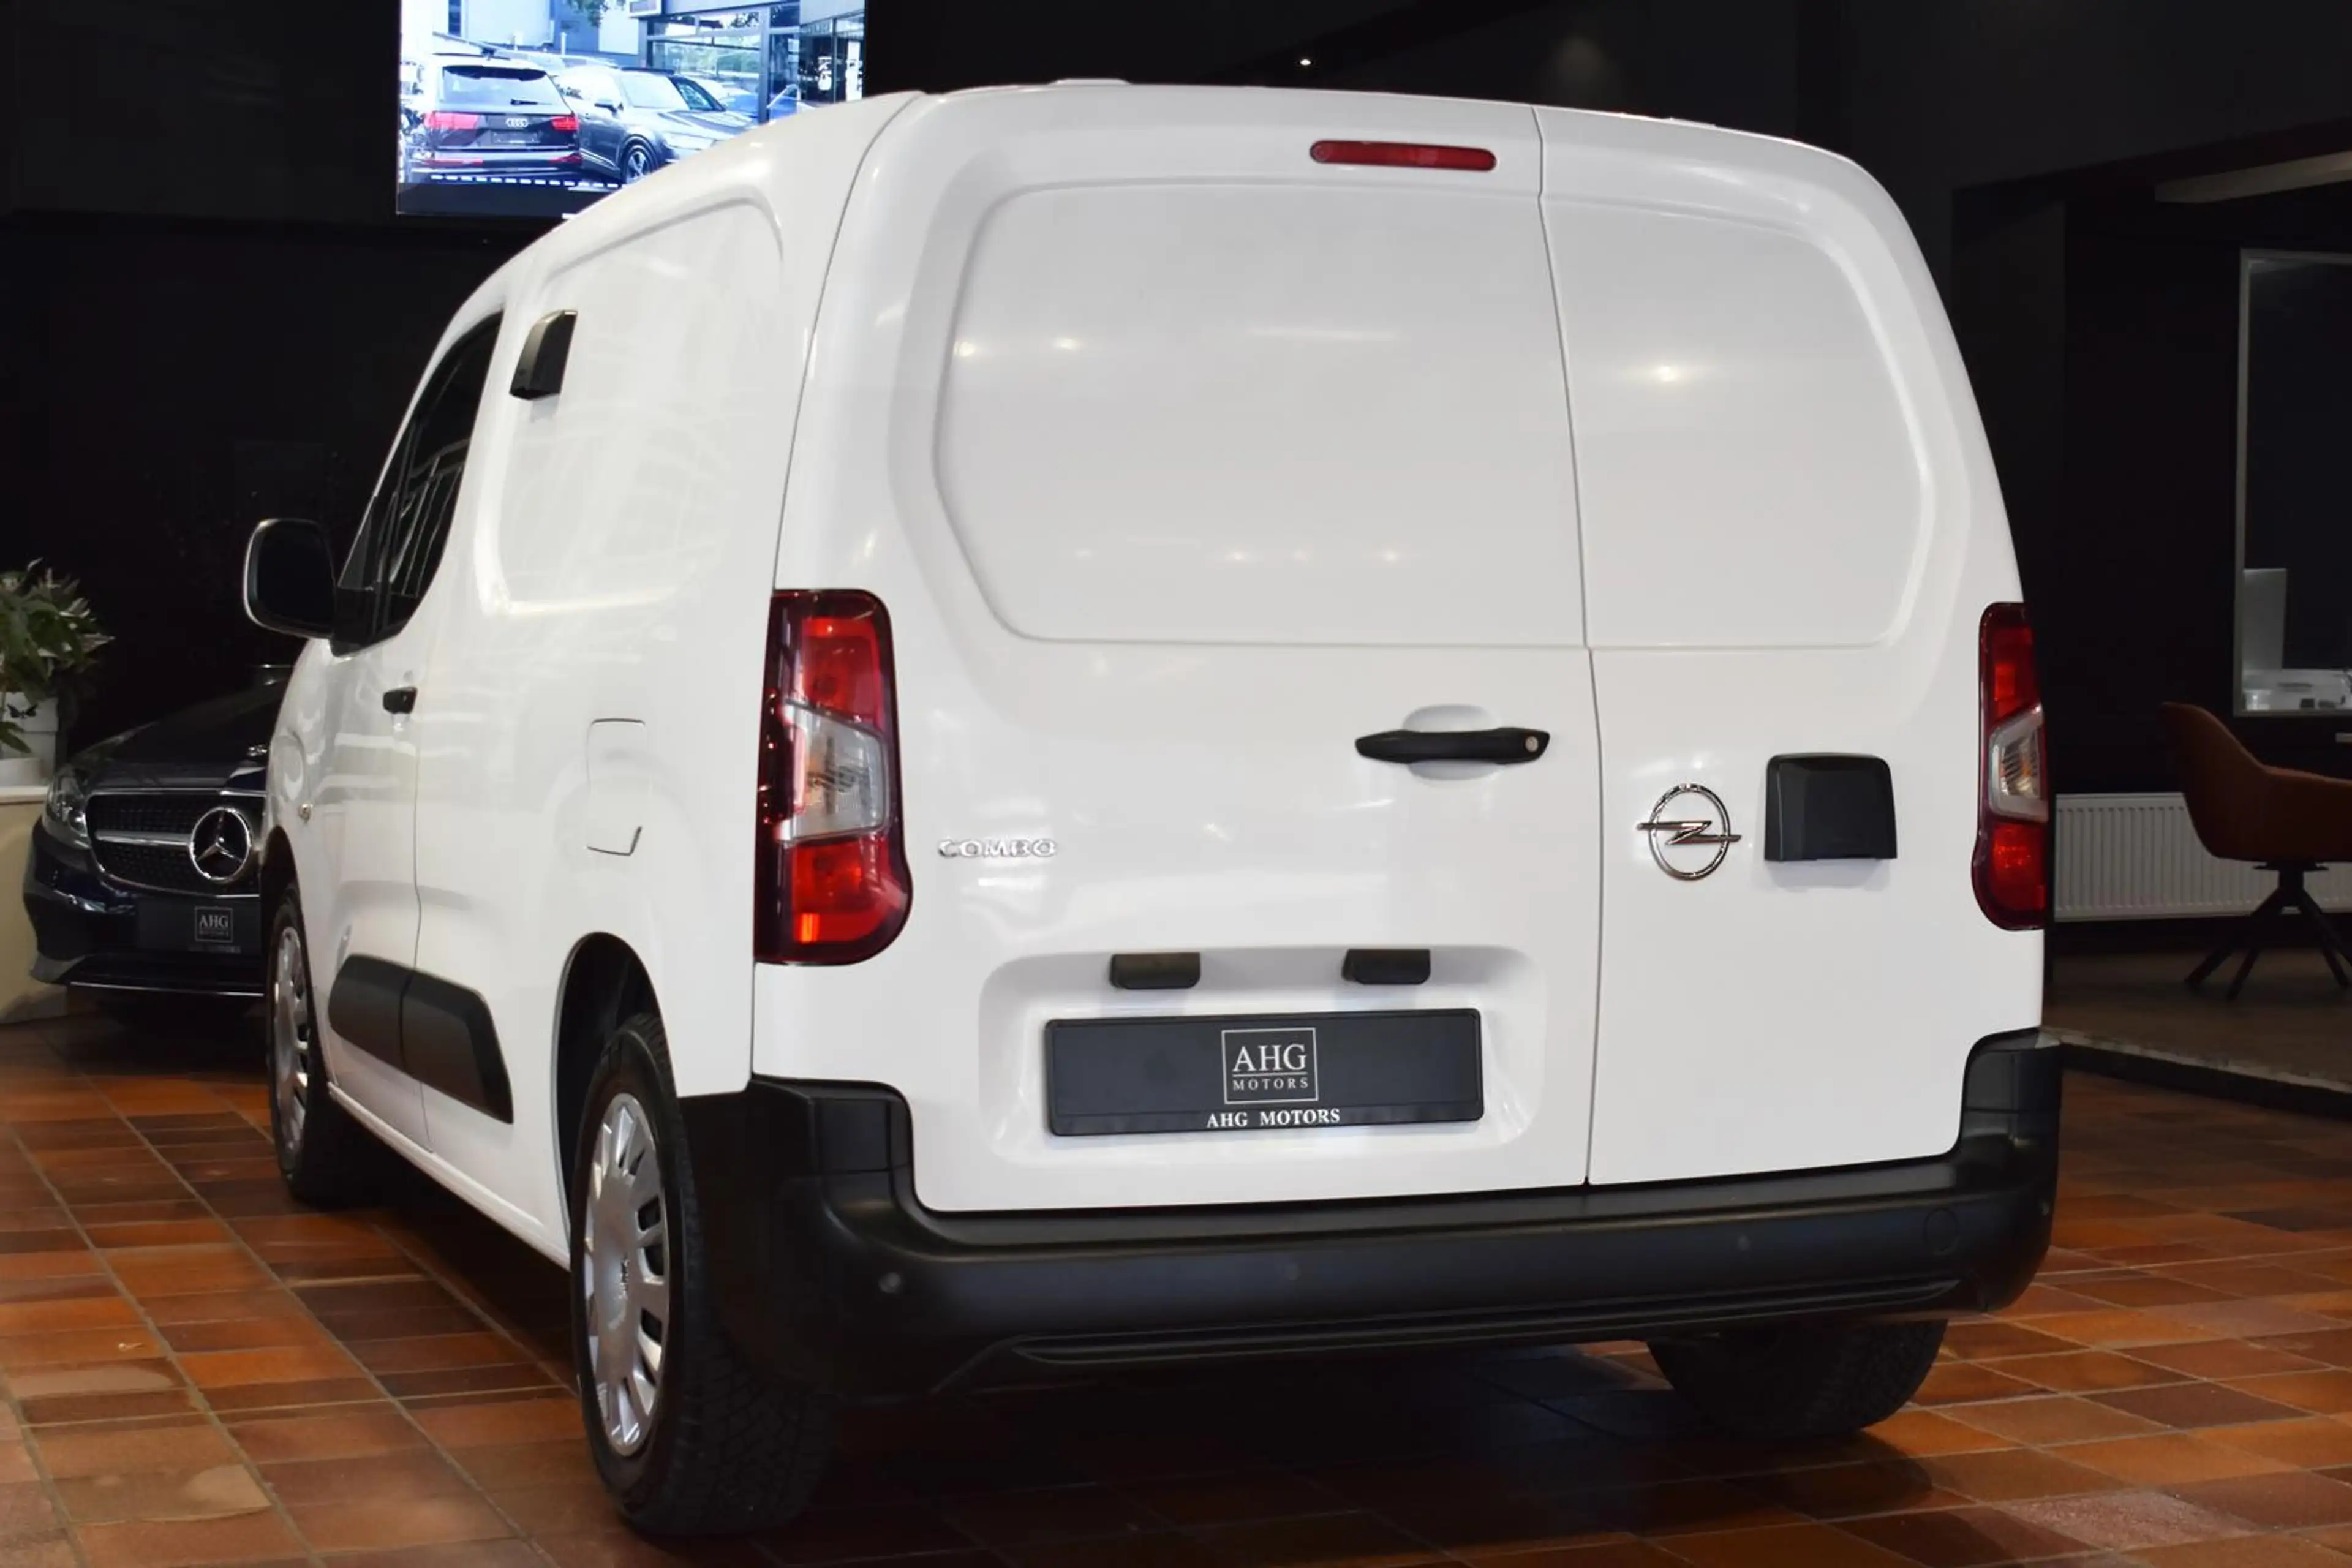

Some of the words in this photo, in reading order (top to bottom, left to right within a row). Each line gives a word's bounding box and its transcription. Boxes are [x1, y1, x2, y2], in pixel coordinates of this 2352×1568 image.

[938, 838, 1057, 858] COMBO
[199, 914, 229, 928] AHG
[1232, 1043, 1308, 1072] AHG
[1232, 1077, 1308, 1091] MOTORS
[1207, 1112, 1248, 1128] AHG
[1259, 1107, 1340, 1126] MOTORS
